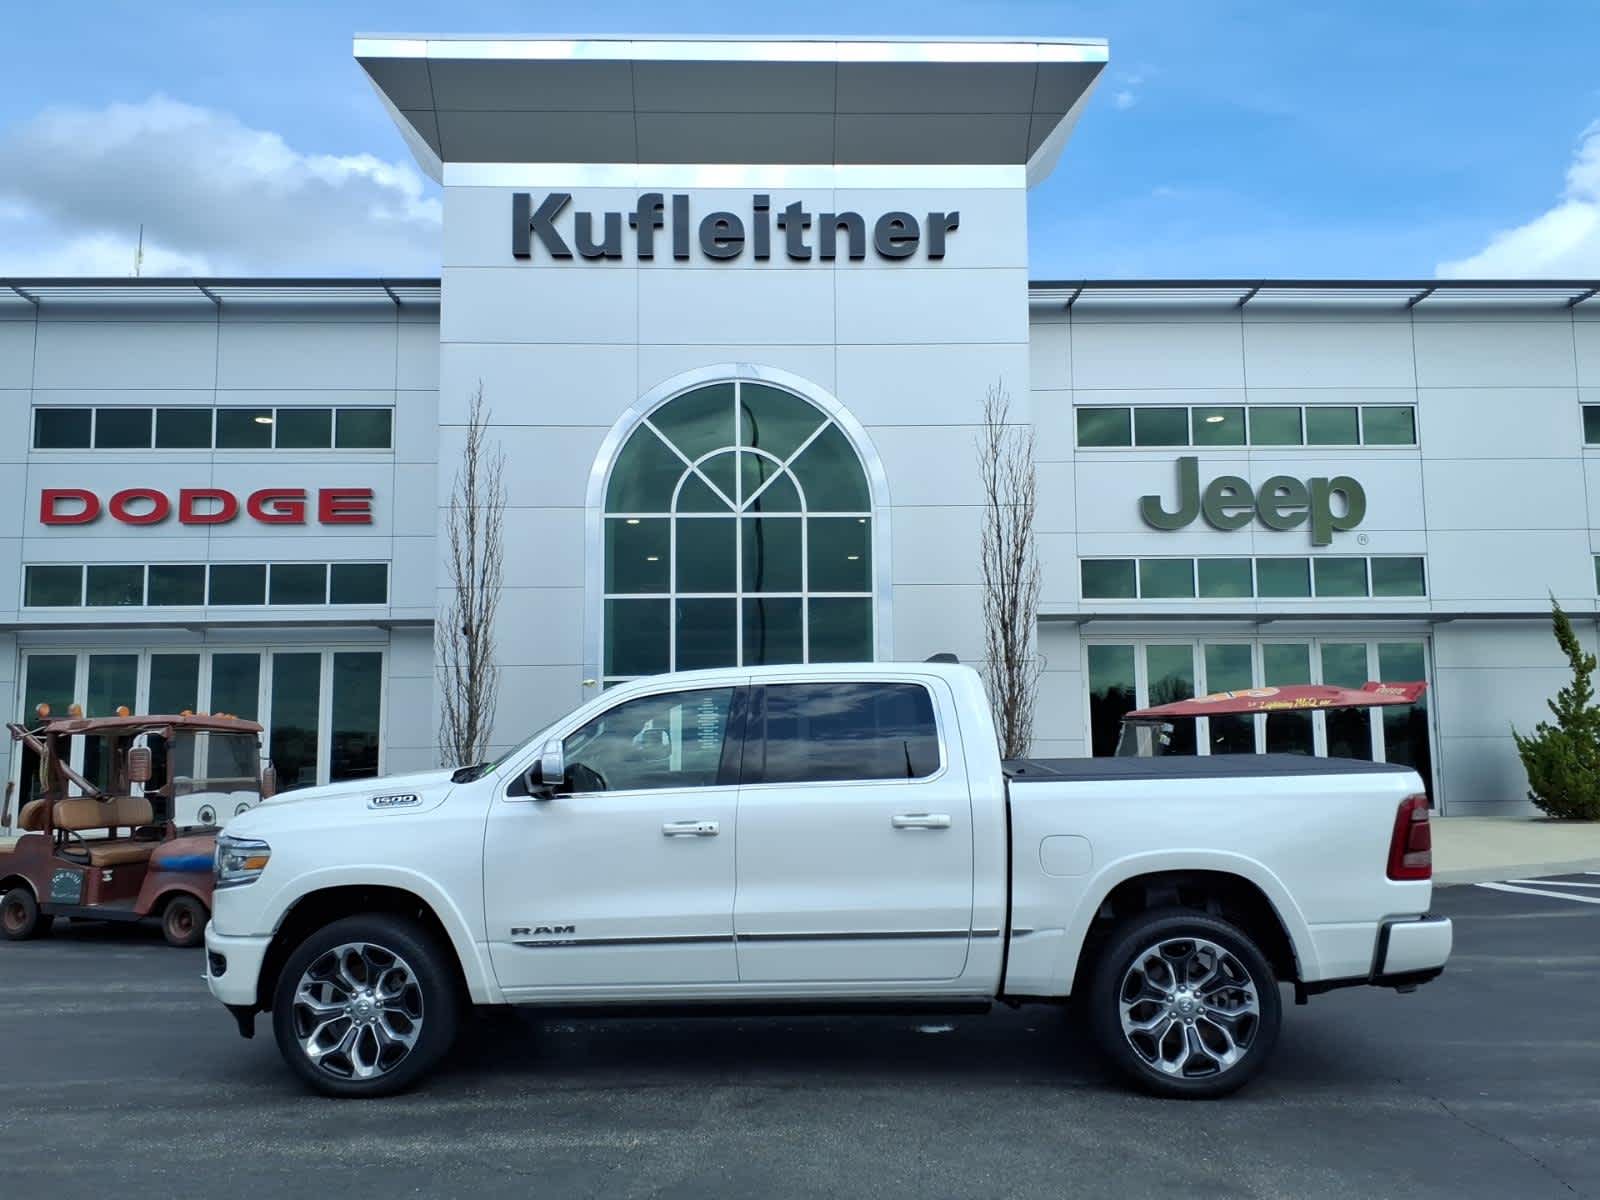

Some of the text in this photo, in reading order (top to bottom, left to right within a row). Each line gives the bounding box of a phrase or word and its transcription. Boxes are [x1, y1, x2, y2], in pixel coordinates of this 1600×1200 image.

[512, 193, 960, 260] Kufleitner
[40, 488, 374, 525] DODGE
[1138, 456, 1367, 547] Jeep
[511, 925, 576, 936] RAM
